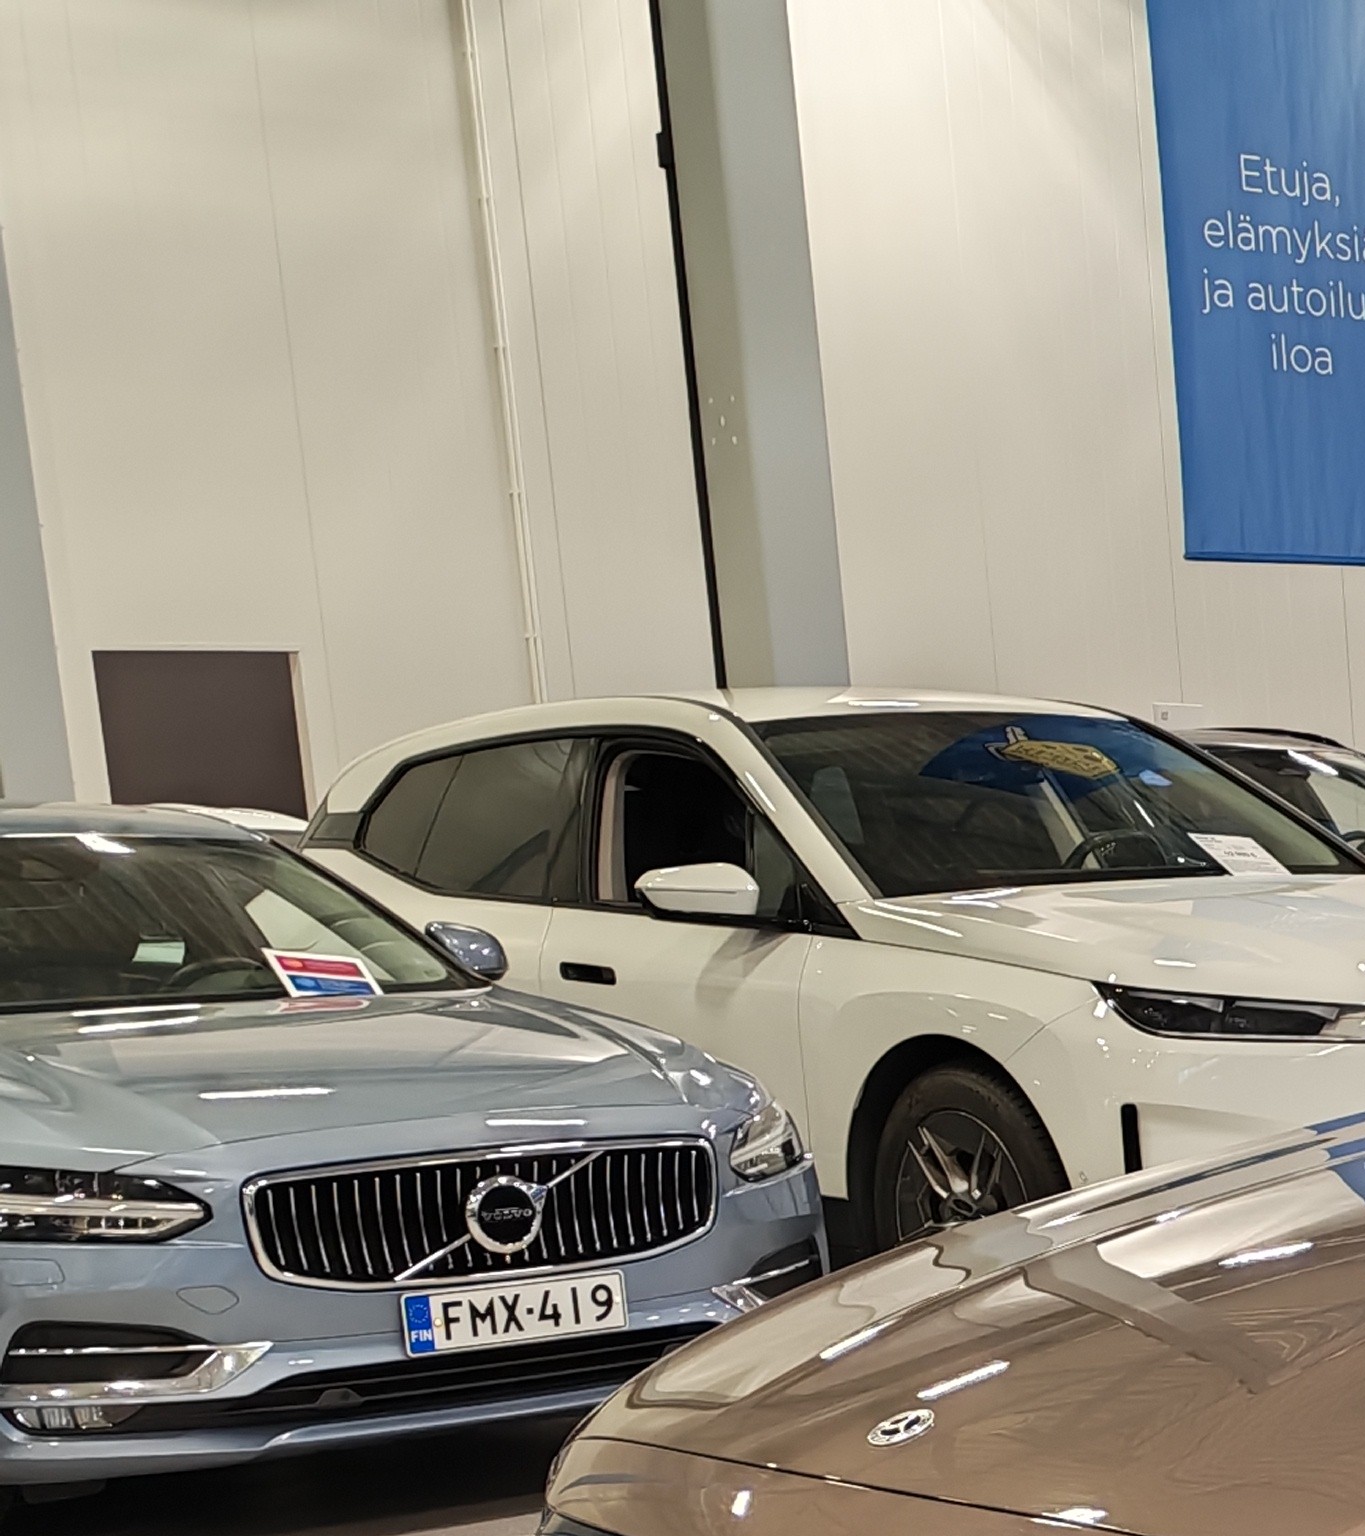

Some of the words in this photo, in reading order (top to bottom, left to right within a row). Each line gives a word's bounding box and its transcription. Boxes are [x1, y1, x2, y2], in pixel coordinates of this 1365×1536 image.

[1238, 152, 1341, 208] Etuja,
[1201, 267, 1235, 315] ja
[1269, 332, 1334, 376] iloa
[410, 1327, 434, 1344] FIN
[440, 1282, 615, 1342] FMX-419
